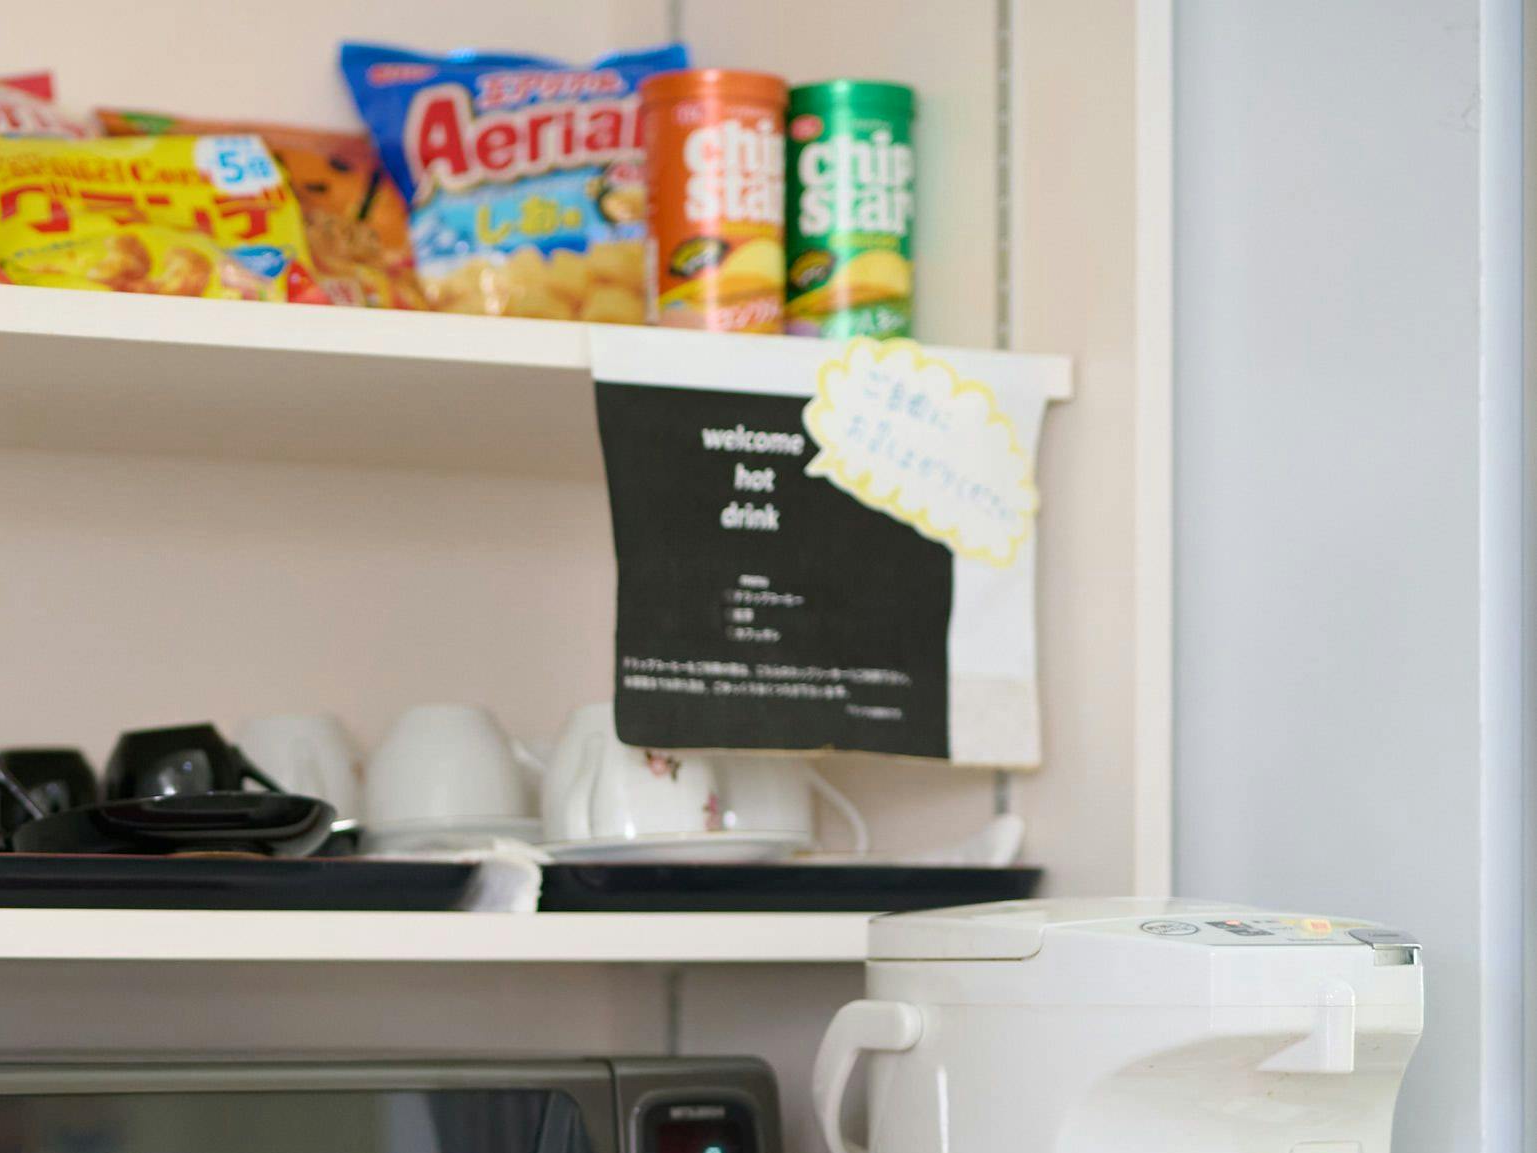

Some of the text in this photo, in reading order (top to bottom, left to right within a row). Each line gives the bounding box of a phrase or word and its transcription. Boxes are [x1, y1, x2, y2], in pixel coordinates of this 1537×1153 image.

[701, 423, 805, 456] welcome
[734, 462, 776, 493] hot
[720, 500, 780, 532] drink
